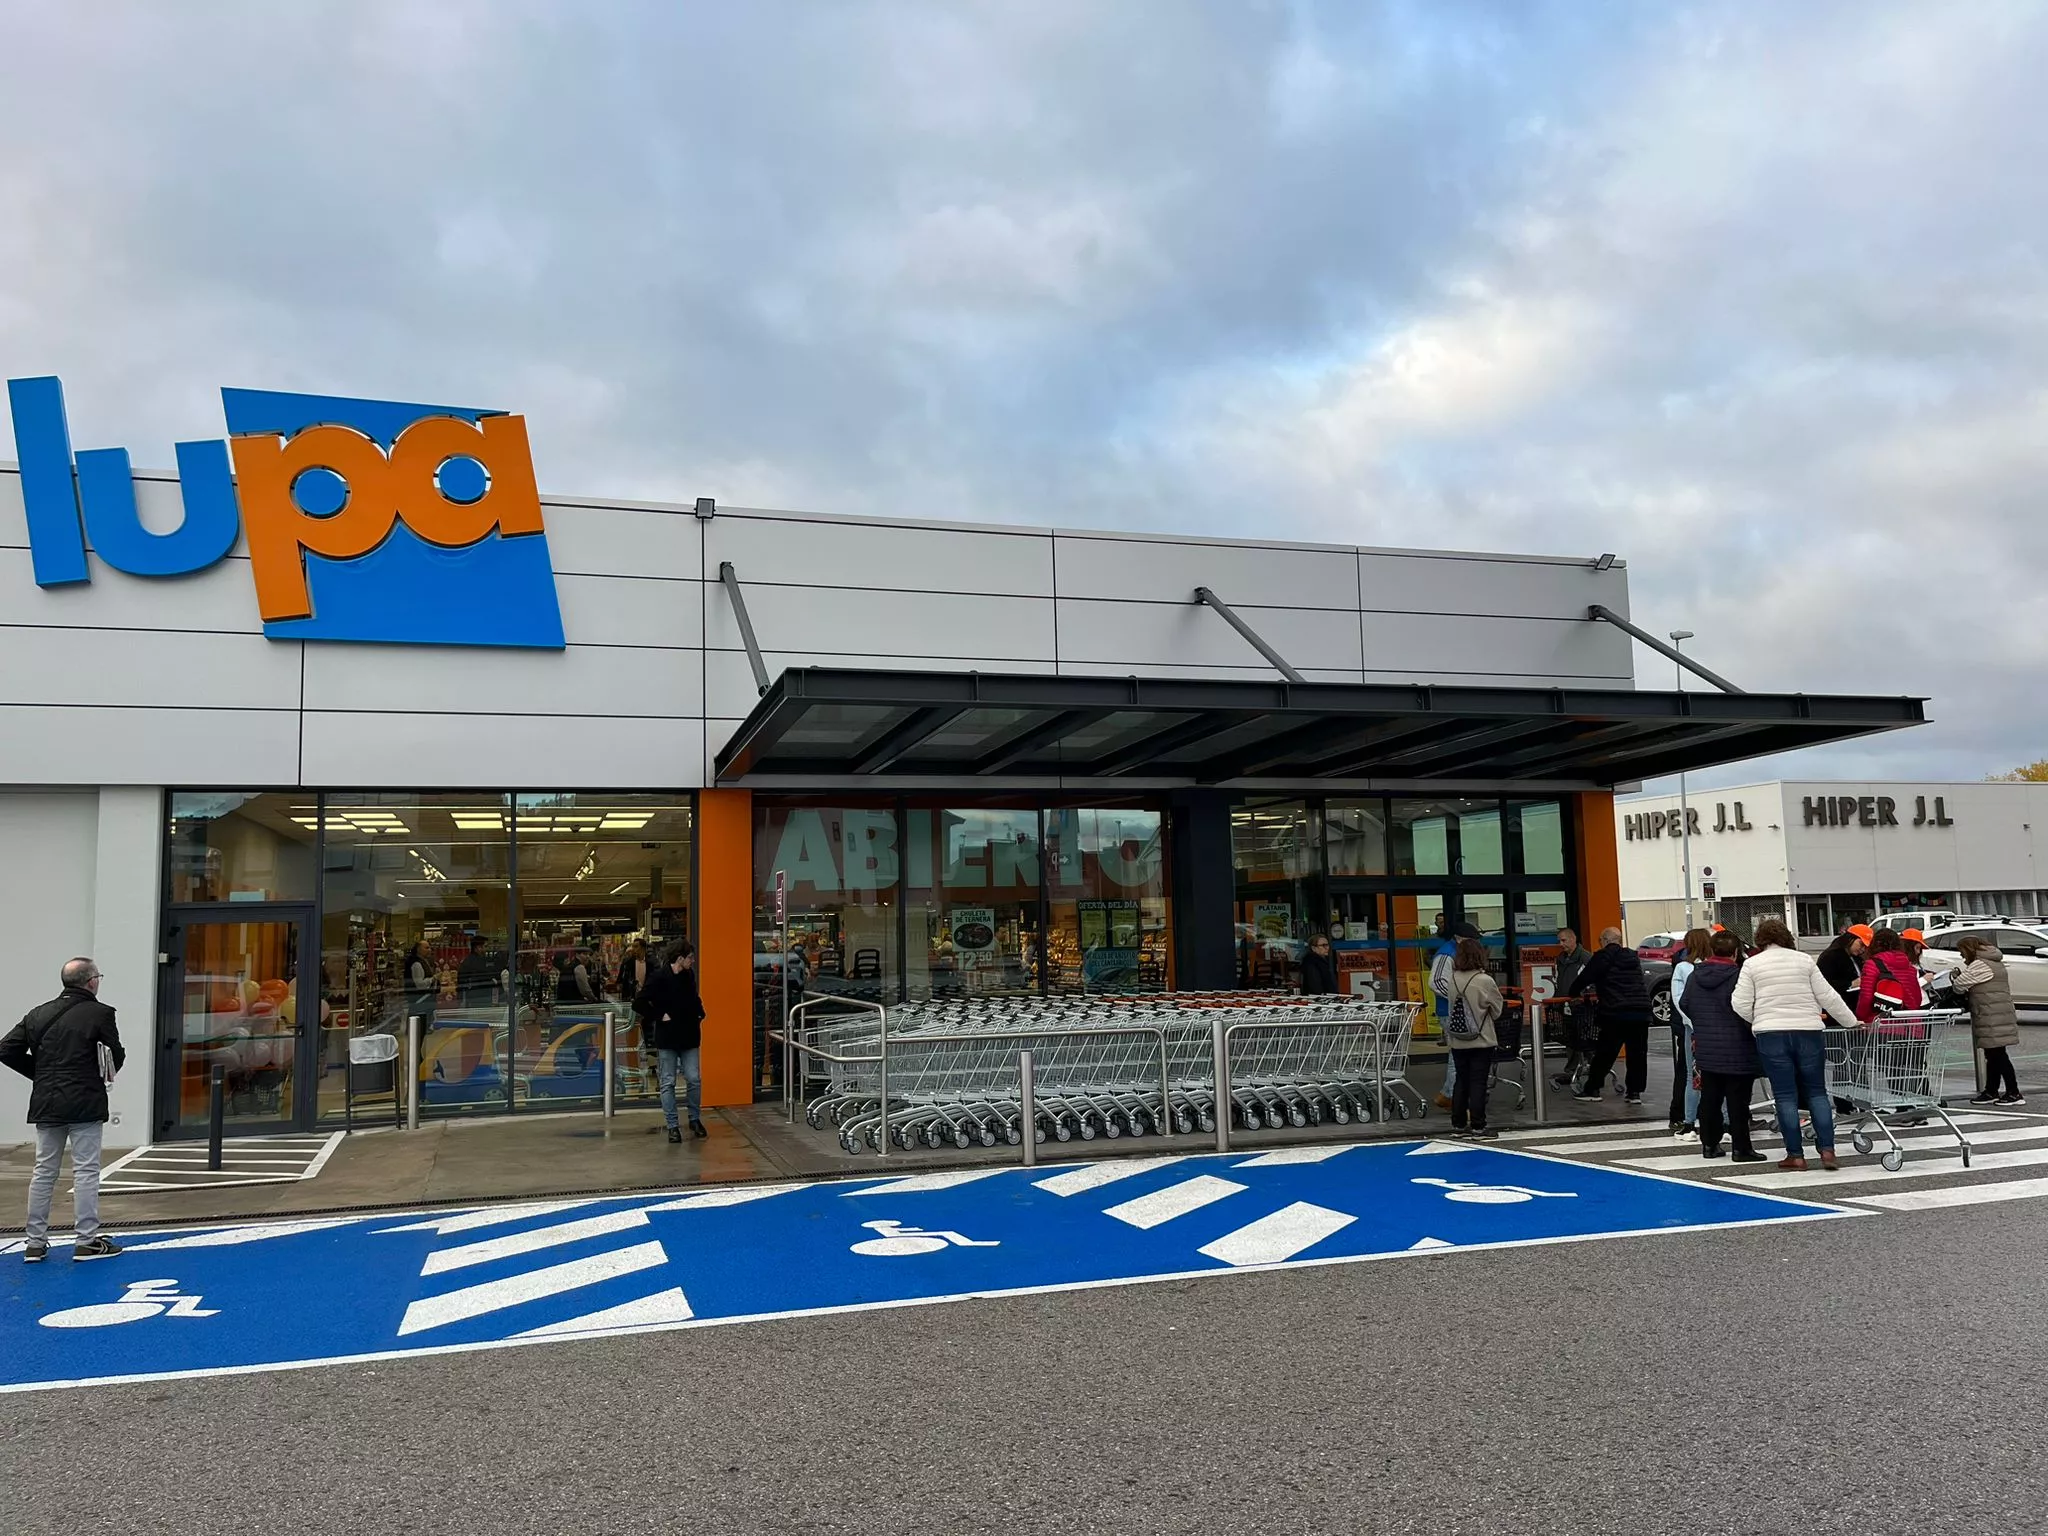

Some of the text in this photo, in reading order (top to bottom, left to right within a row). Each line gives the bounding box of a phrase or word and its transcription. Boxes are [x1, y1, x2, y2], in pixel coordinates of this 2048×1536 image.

[7, 375, 545, 623] lupa
[1624, 801, 1753, 842] HIPER J.L
[1802, 795, 1954, 827] HIPER J.L
[1079, 900, 1138, 910] OFERTA DEL DÍA
[1340, 960, 1385, 968] DESCUENTO
